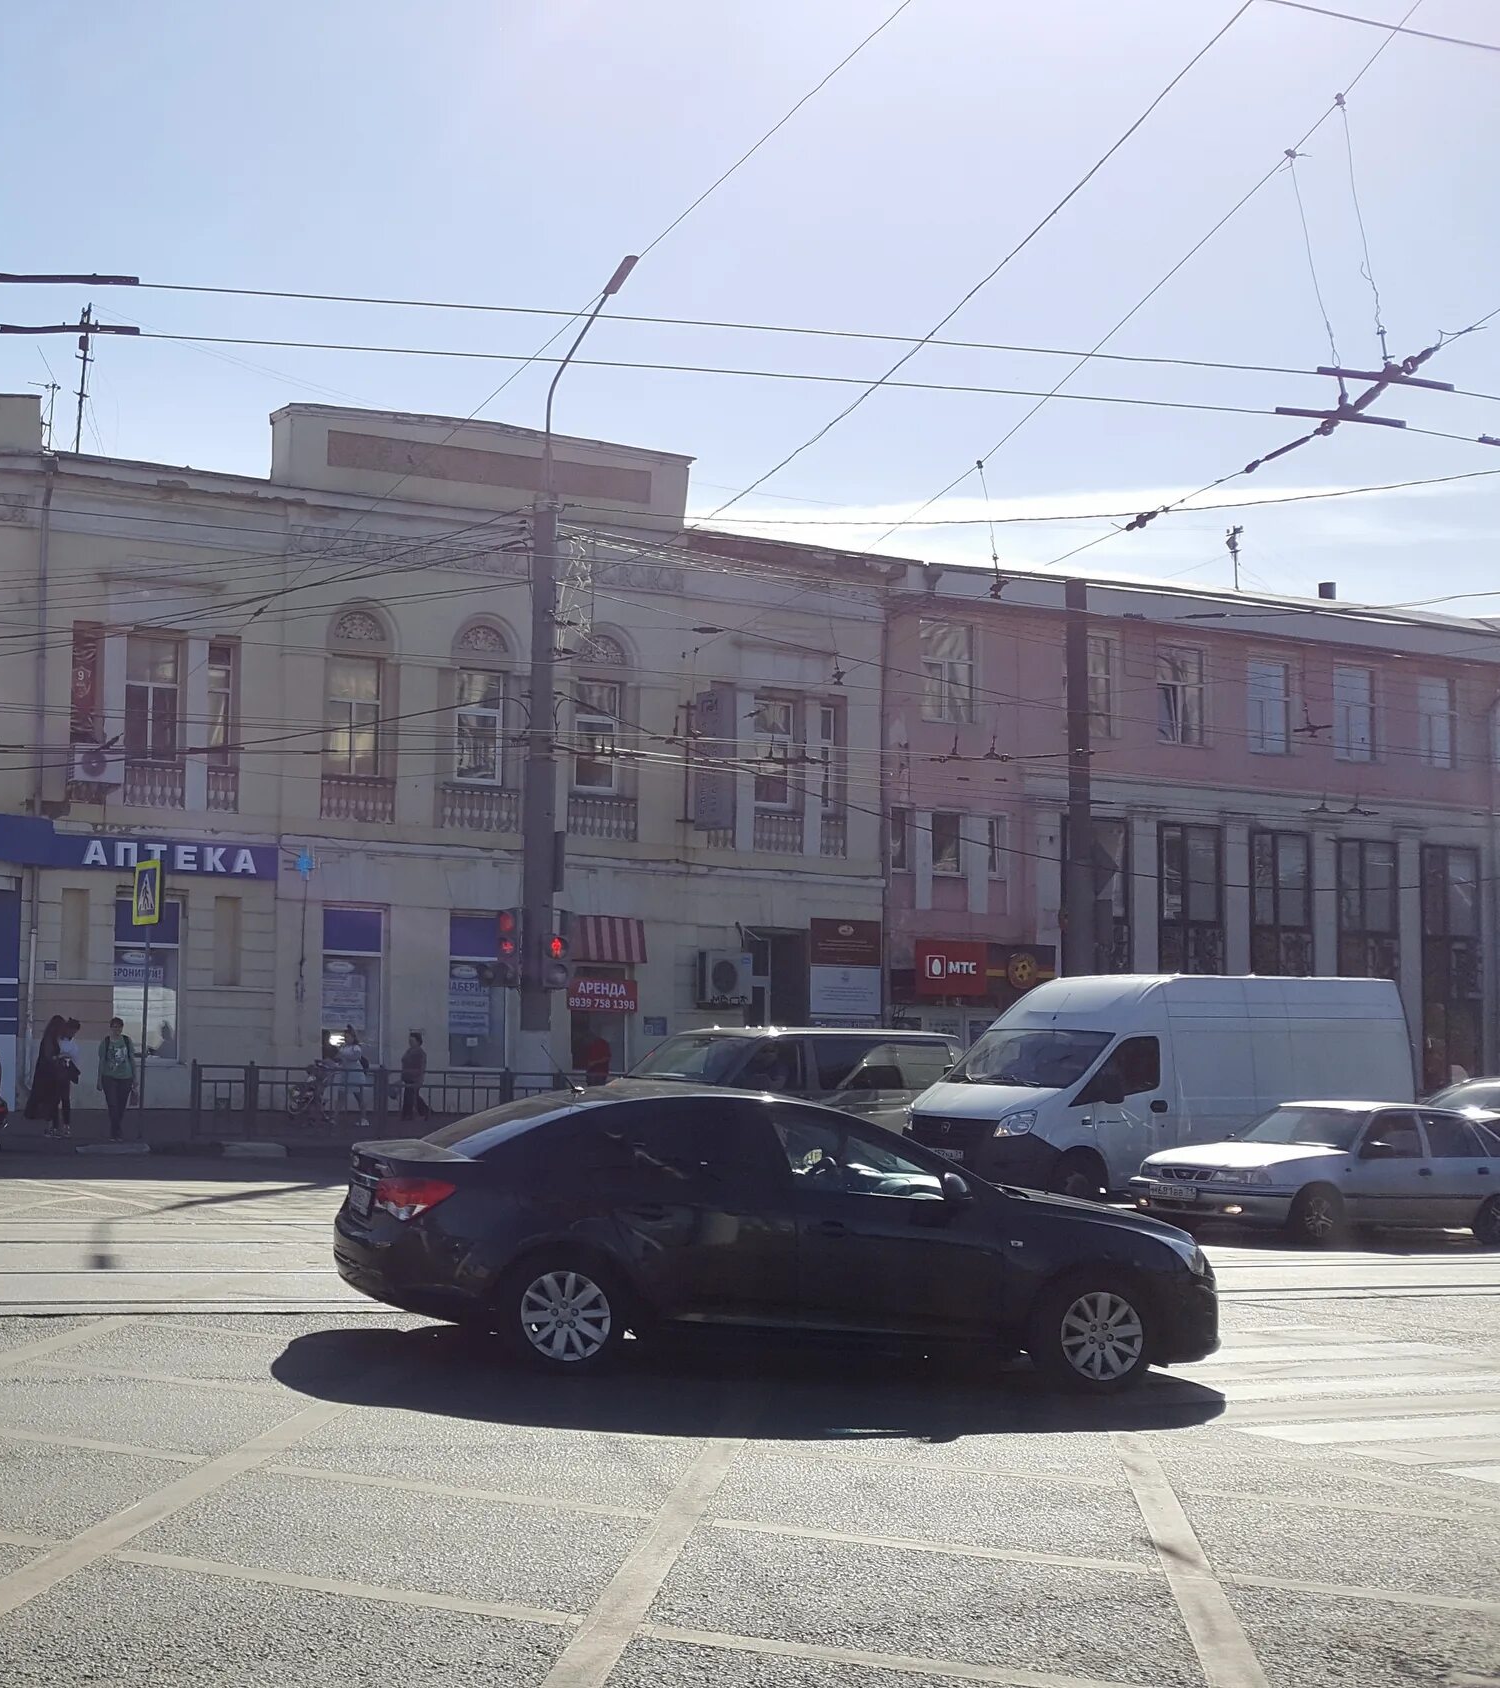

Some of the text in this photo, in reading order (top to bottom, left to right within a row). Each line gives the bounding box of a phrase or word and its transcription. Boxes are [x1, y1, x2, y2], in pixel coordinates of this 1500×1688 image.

[80, 839, 258, 875] АПТЕКА
[947, 960, 977, 975] МТС
[577, 981, 627, 998] АРЕНДА
[594, 998, 611, 1009] 758
[613, 1000, 635, 1010] 1398
